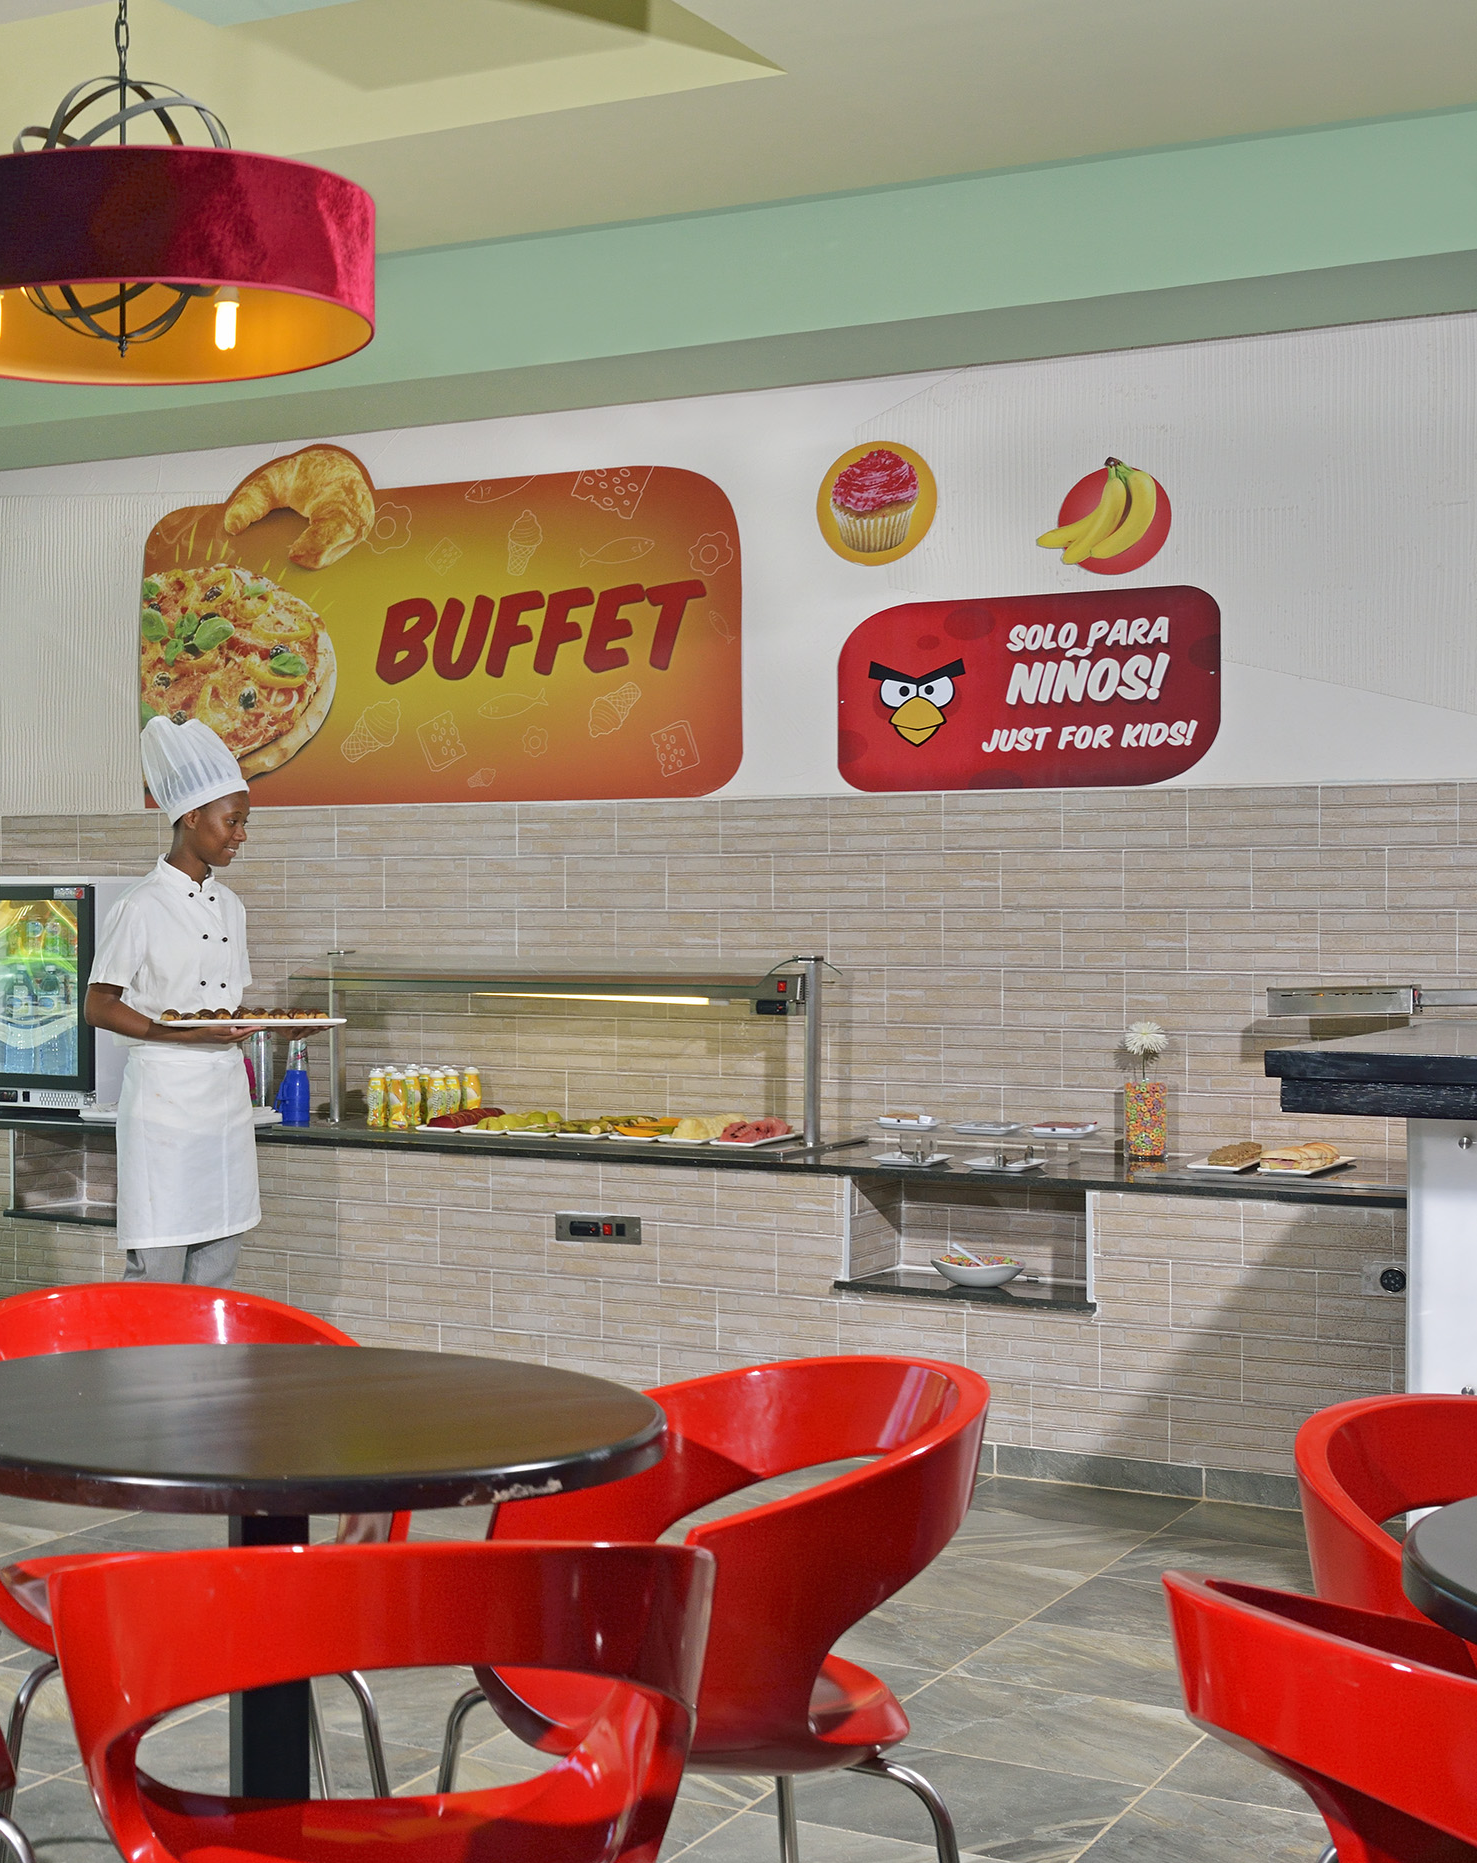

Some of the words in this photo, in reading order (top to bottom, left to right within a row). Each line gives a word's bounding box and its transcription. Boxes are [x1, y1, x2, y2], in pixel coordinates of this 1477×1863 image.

[375, 579, 707, 685] BUFFET
[1006, 622, 1078, 651] SOLO
[1087, 616, 1169, 647] PARA
[1005, 647, 1170, 705] NIÑOS!
[981, 727, 1052, 752] JUST
[1057, 725, 1114, 750] FOR
[1120, 719, 1198, 746] KIDS!
